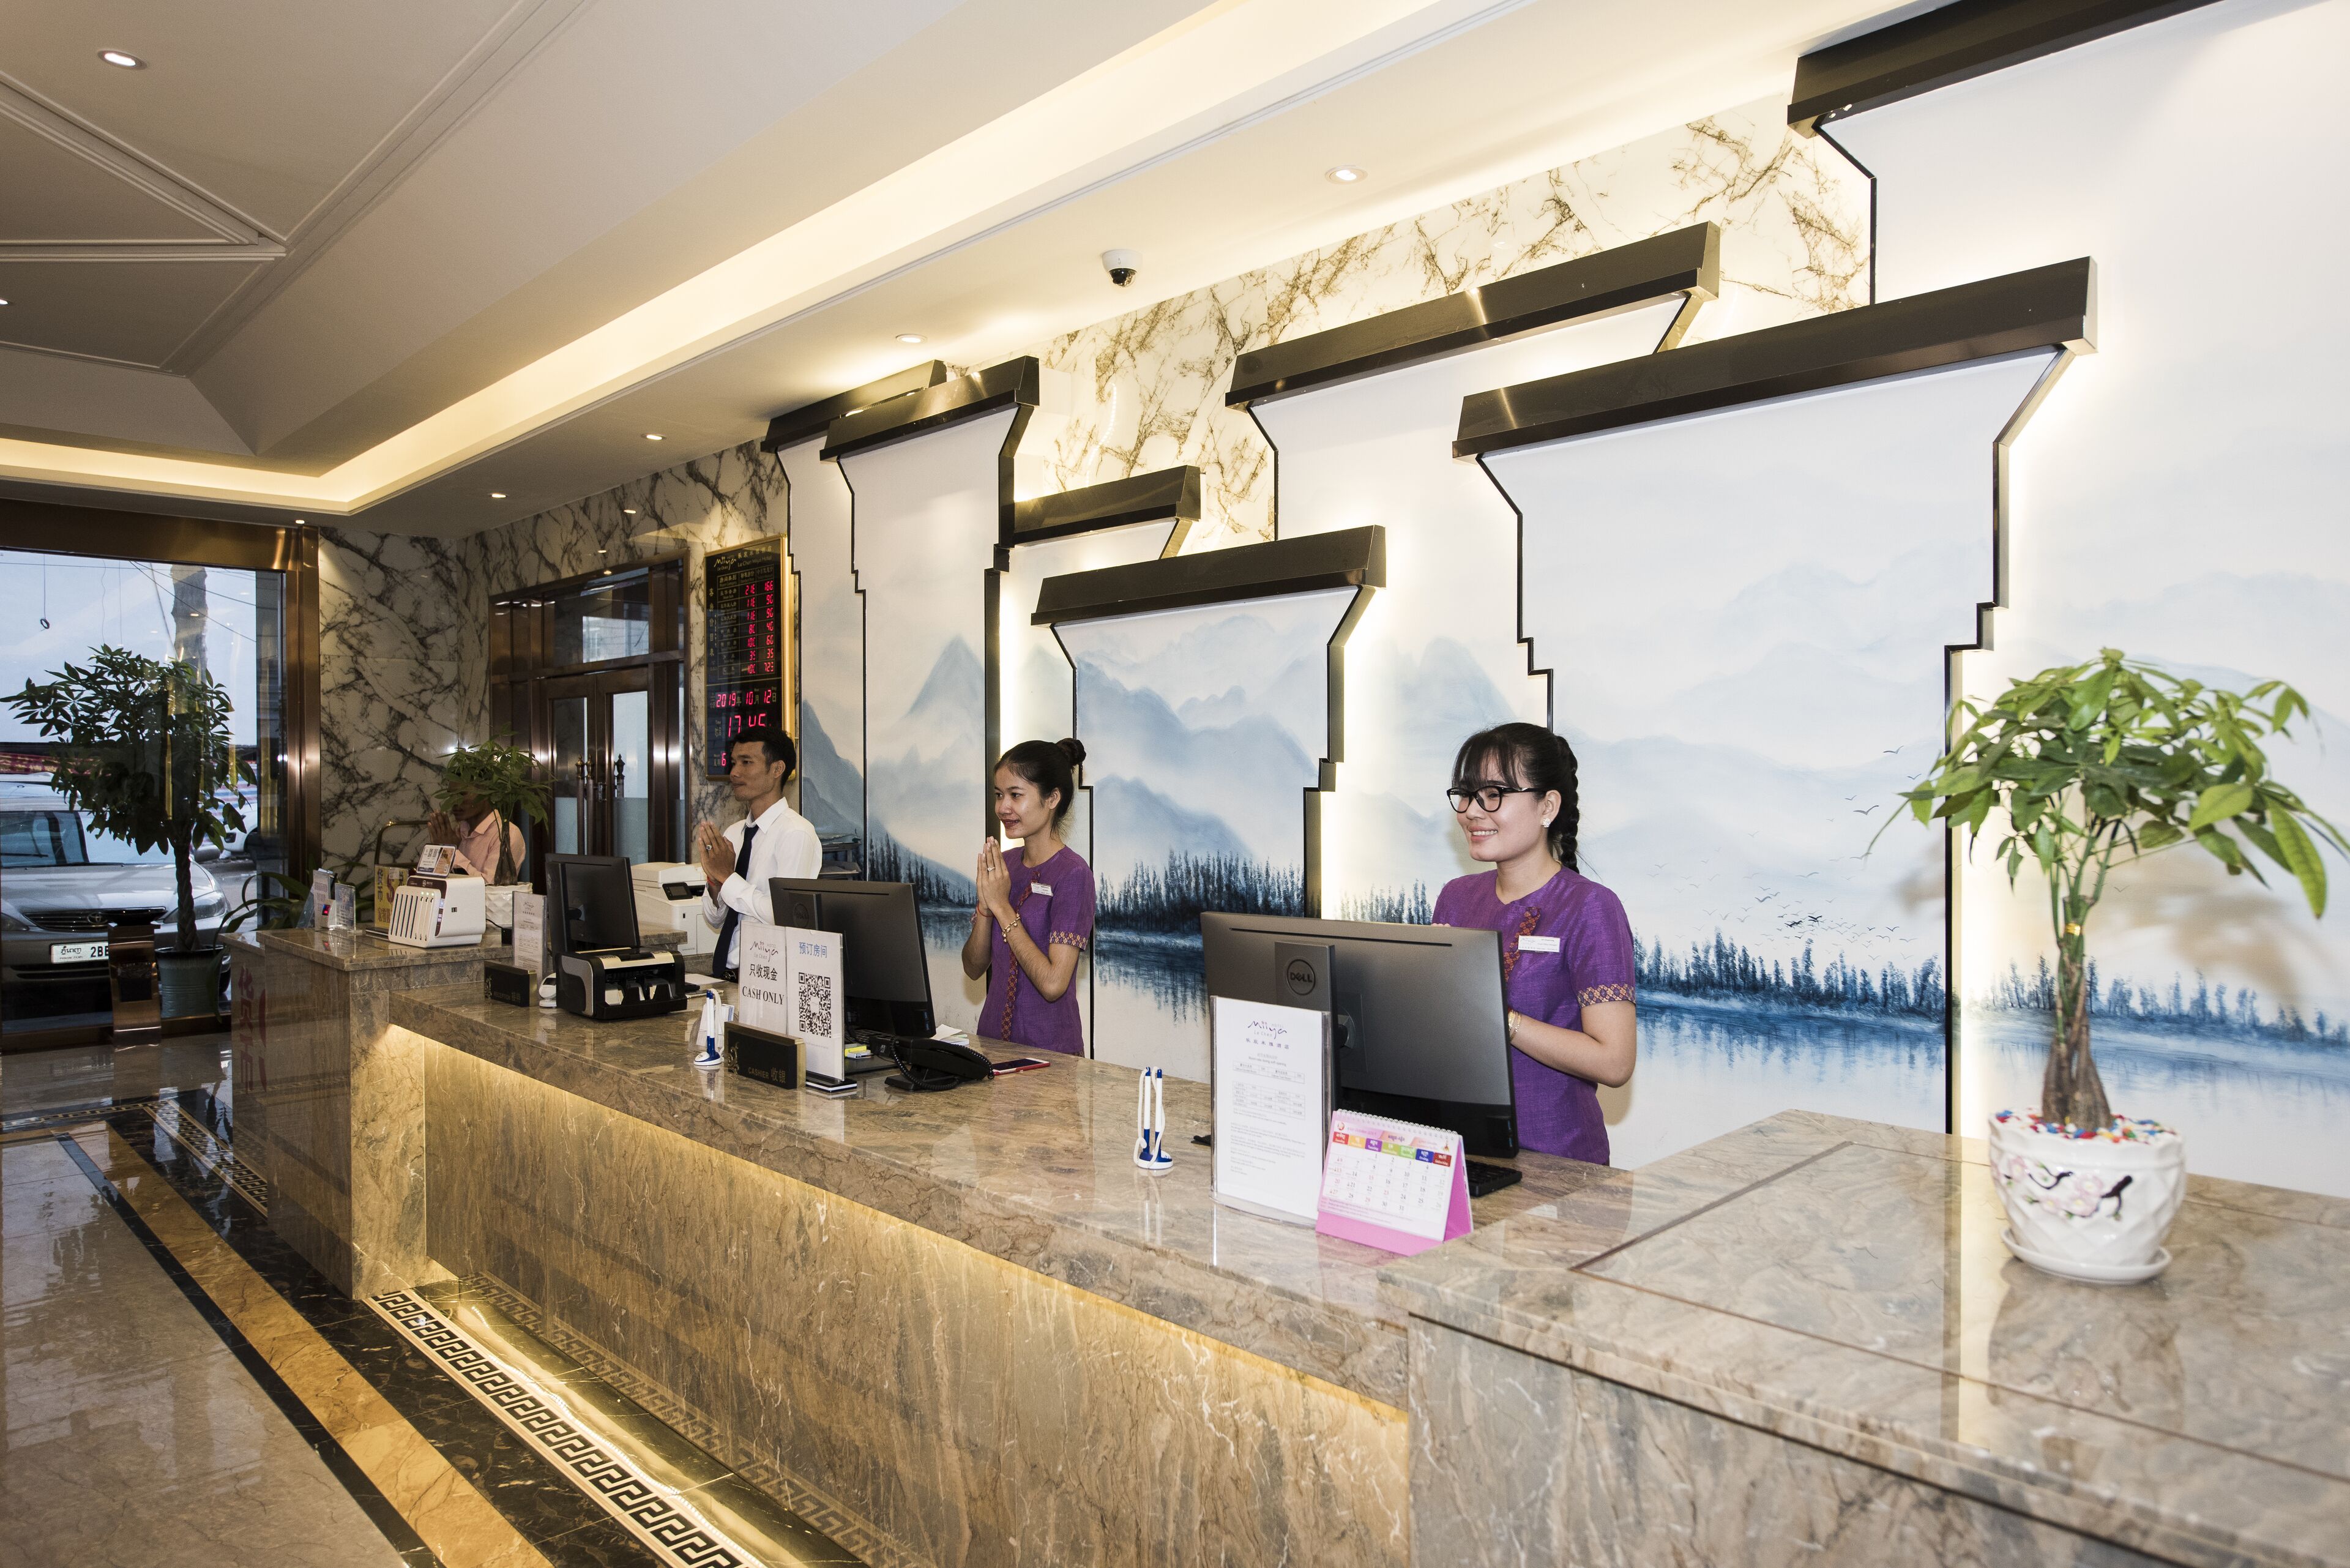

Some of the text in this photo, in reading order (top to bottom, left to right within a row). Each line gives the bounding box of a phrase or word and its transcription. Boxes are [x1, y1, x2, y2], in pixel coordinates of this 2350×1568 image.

[716, 693, 736, 707] 2019
[736, 696, 742, 706] 年
[746, 691, 753, 705] 10
[754, 695, 759, 704] 月
[764, 689, 772, 704] 12
[772, 692, 777, 702] 日
[728, 715, 741, 737] 17
[722, 753, 726, 766] 6
[799, 942, 827, 958] 预订房间
[750, 963, 778, 981] 只收现金
[1290, 972, 1313, 983] DELL
[742, 986, 785, 1005] CASH ONLY
[1248, 1020, 1287, 1039] Miiya
[748, 1067, 769, 1080] CASHIER
